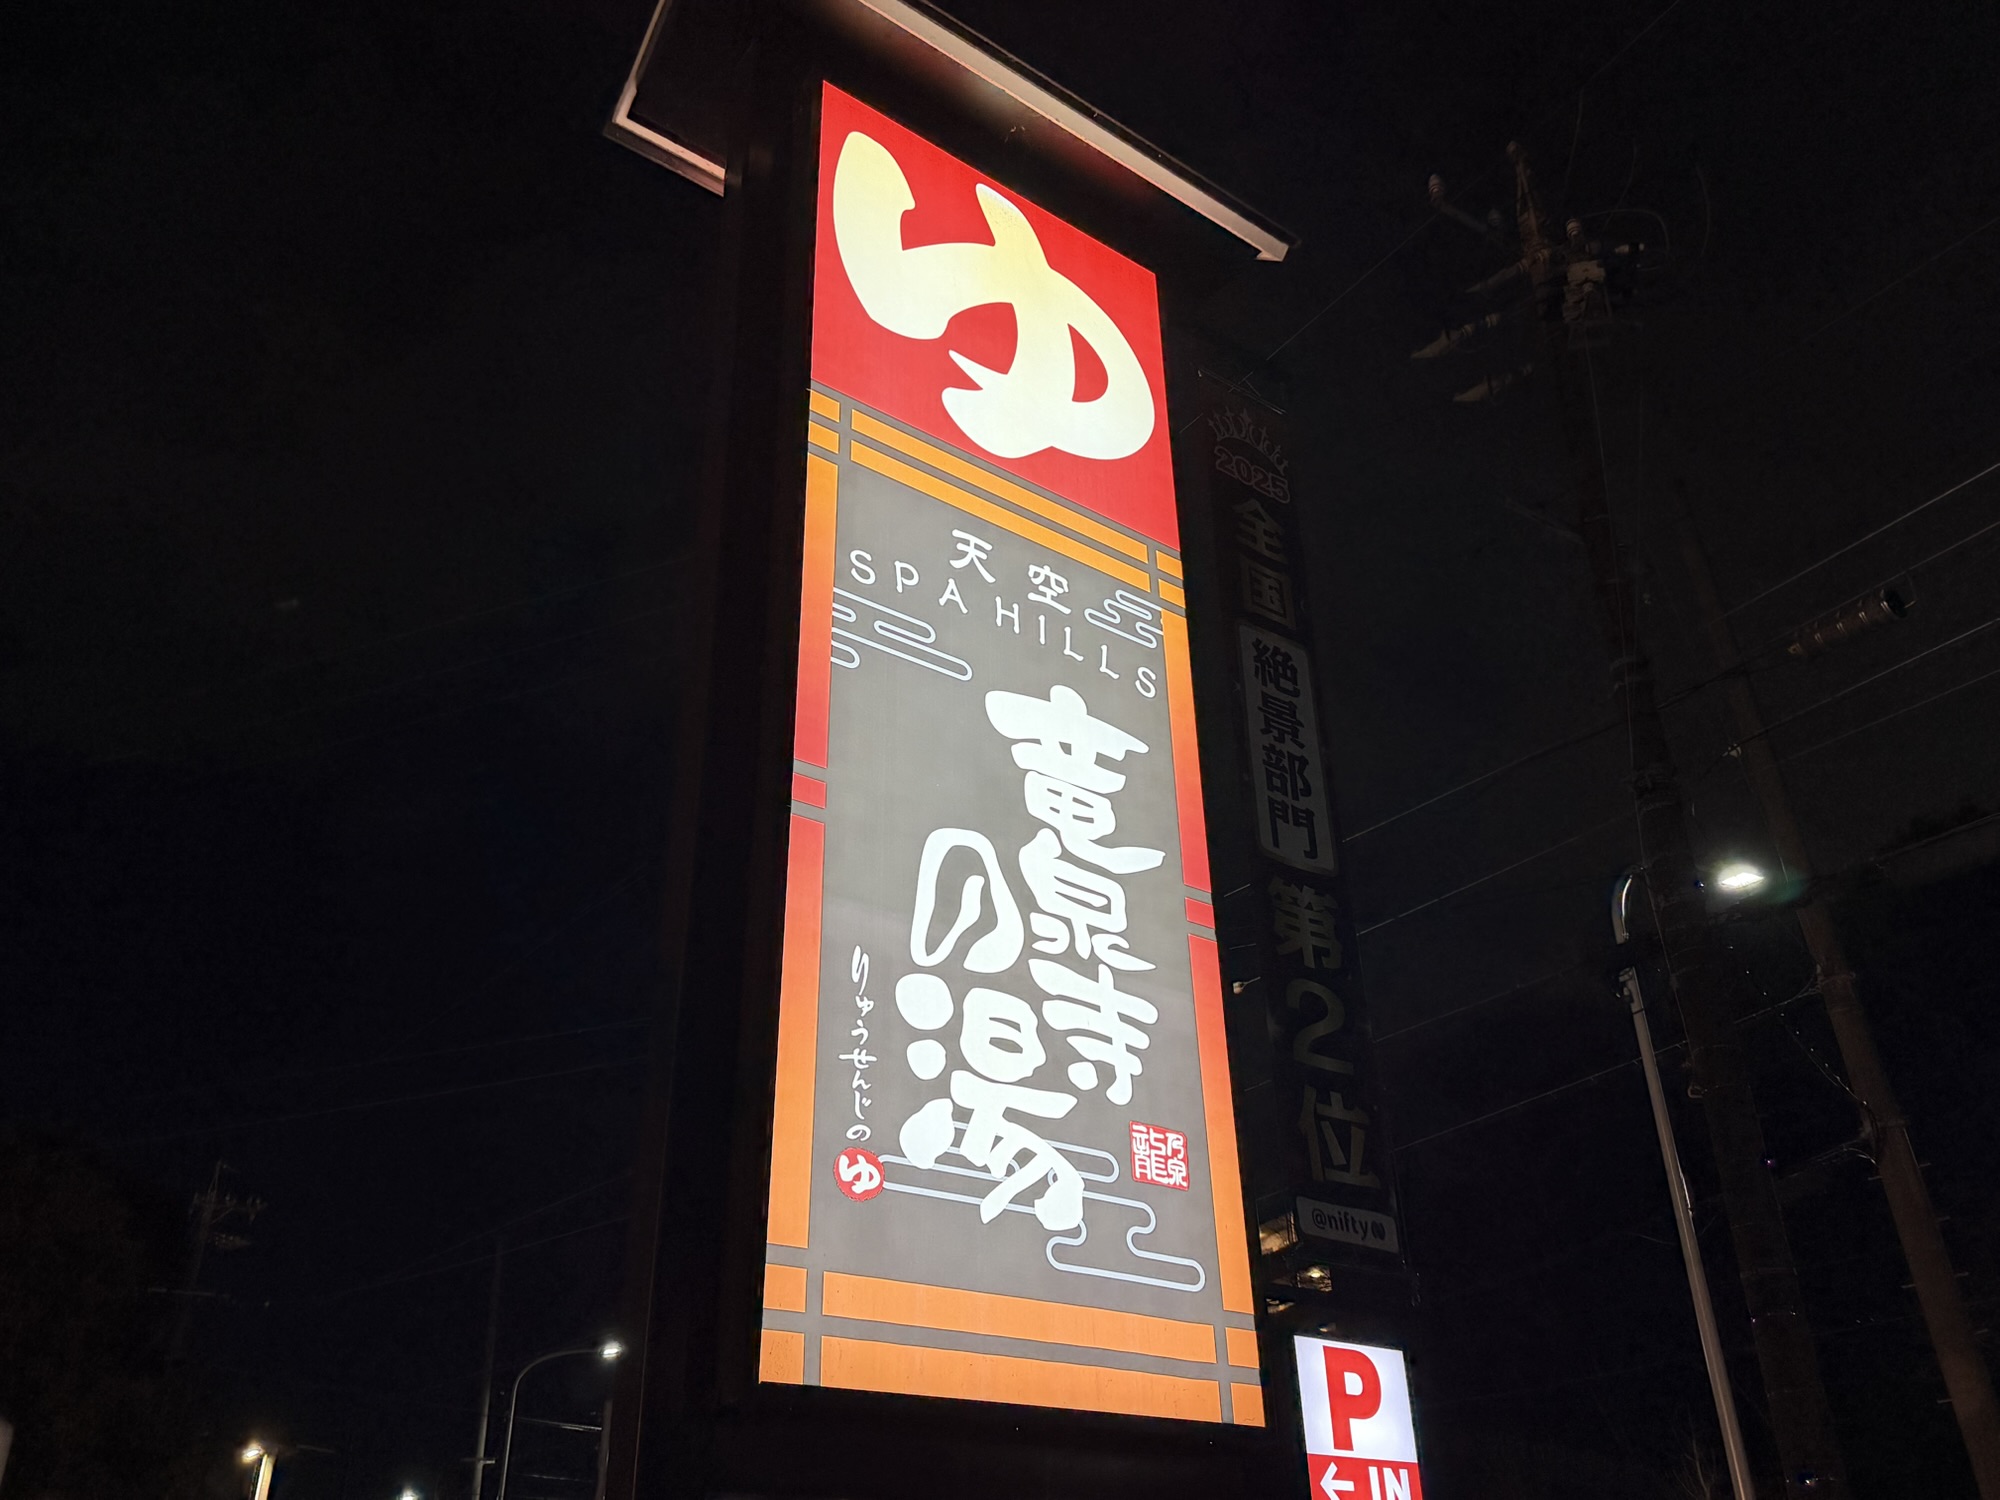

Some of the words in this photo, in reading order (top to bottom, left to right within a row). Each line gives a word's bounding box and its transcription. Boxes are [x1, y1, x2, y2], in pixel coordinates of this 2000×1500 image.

[832, 130, 1156, 461] ゆ
[1214, 445, 1291, 504] 2025
[849, 549, 969, 614] SPA
[949, 528, 1072, 615] 天空
[1231, 499, 1297, 631] 全国
[1251, 637, 1318, 860] 絶景部門
[1268, 876, 1382, 1191] 第2位
[838, 1153, 882, 1195] ゆ
[1311, 1207, 1369, 1241] @nifty
[1322, 1344, 1382, 1452] P
[1367, 1465, 1412, 1500] IN
